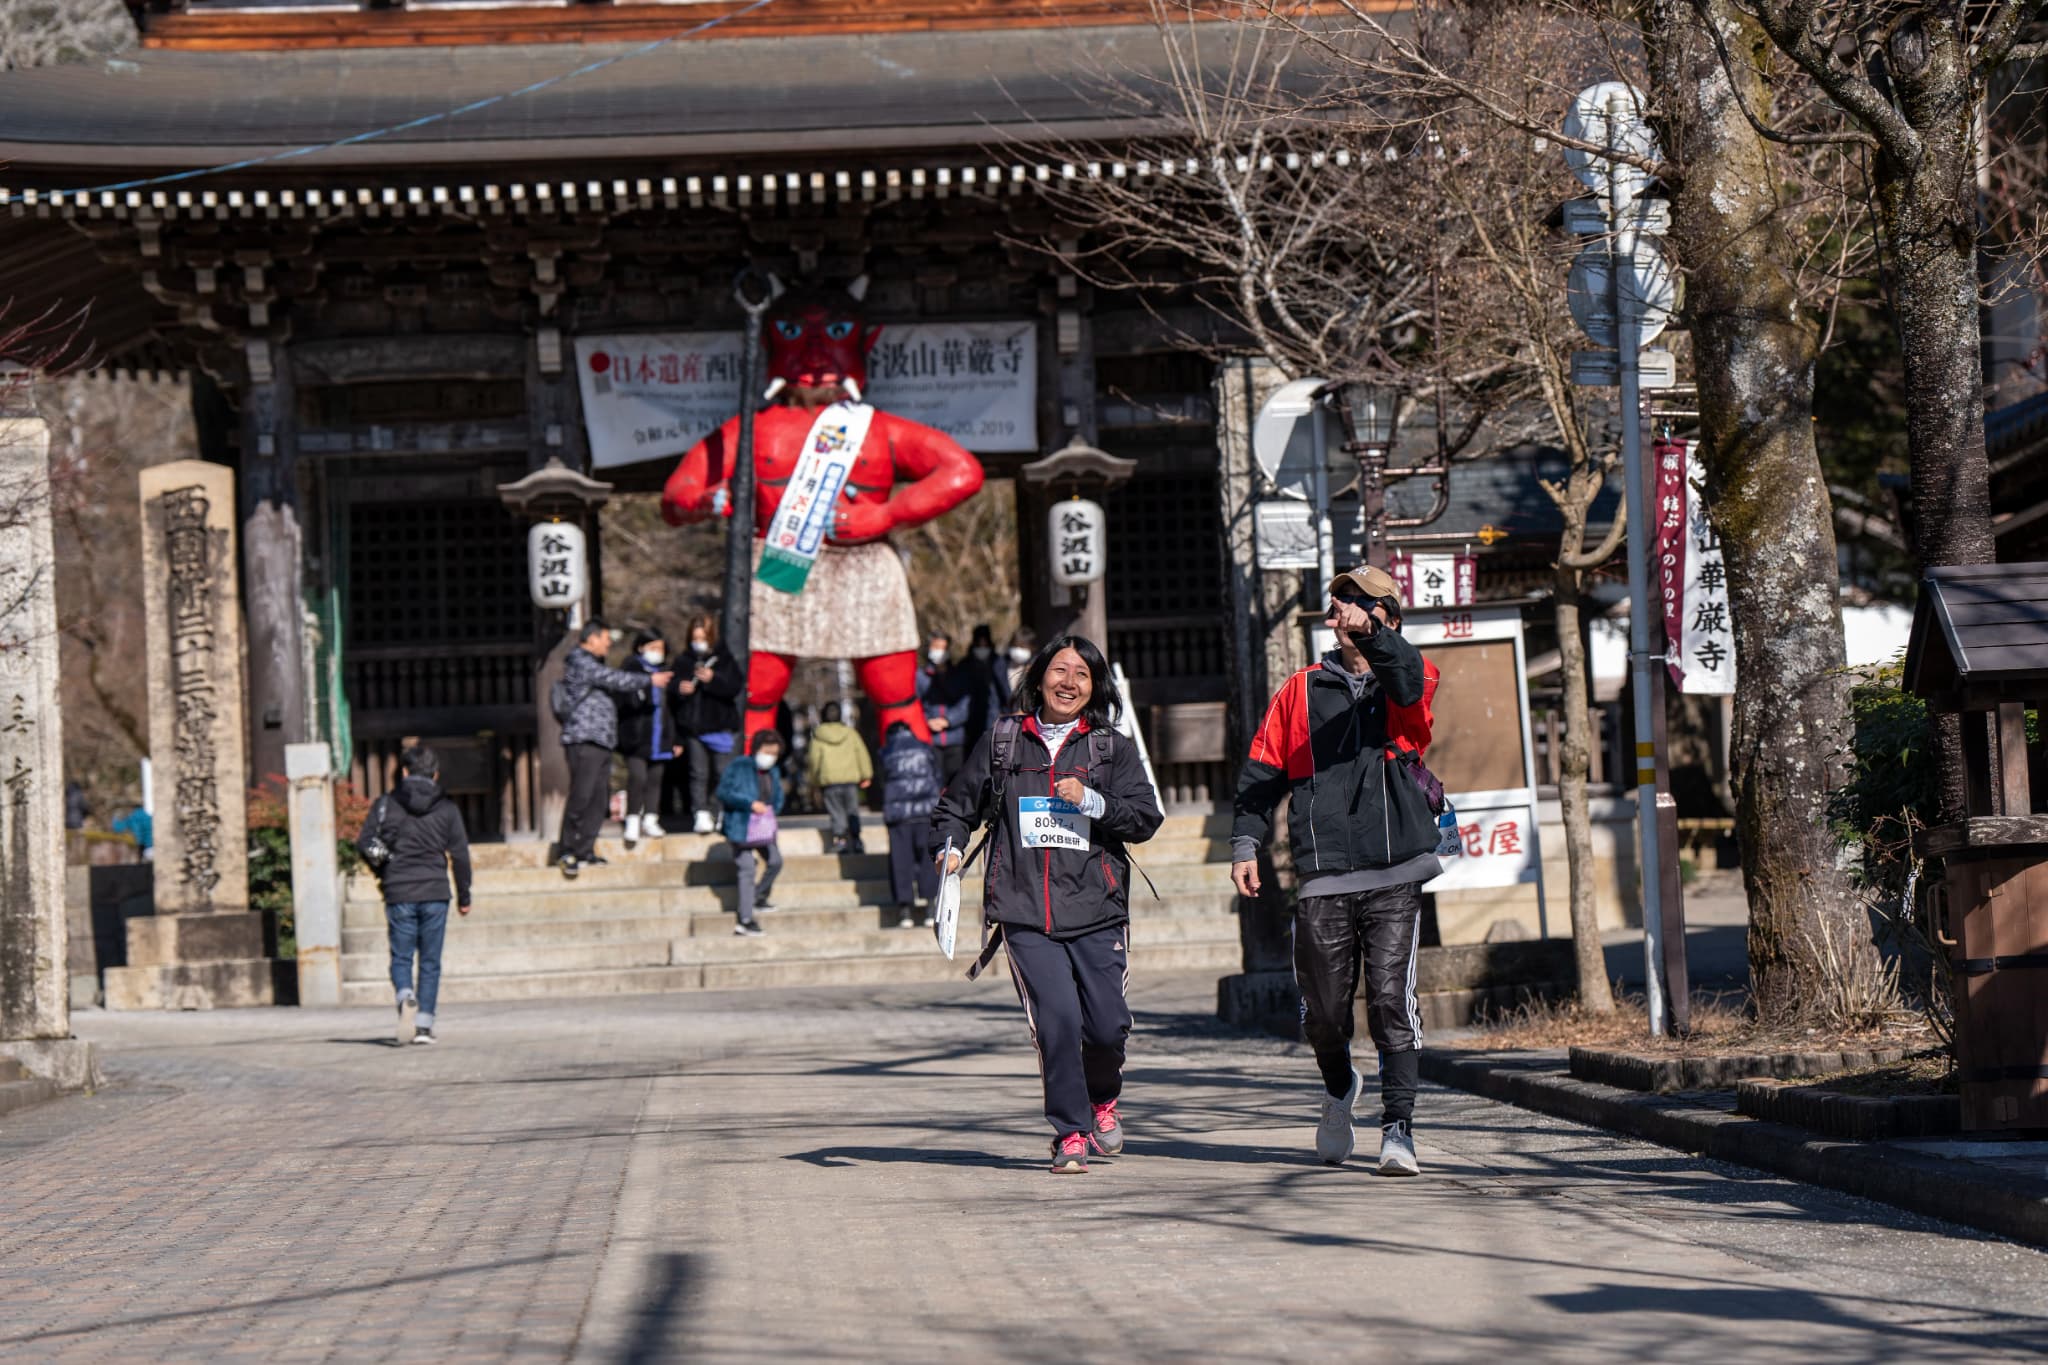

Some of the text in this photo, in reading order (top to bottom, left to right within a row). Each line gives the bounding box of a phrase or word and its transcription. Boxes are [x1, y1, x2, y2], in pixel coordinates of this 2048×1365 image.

[980, 420, 1016, 436] 2019
[1061, 511, 1092, 575] 谷汲山
[1661, 453, 1680, 618] 願い 結ぶ いのりの里
[541, 533, 573, 598] 谷汲山
[1690, 505, 1729, 672] 山華厳寺
[1442, 611, 1474, 639] 迎
[1034, 816, 1075, 831] 8097-4
[1450, 821, 1523, 858] 花屋
